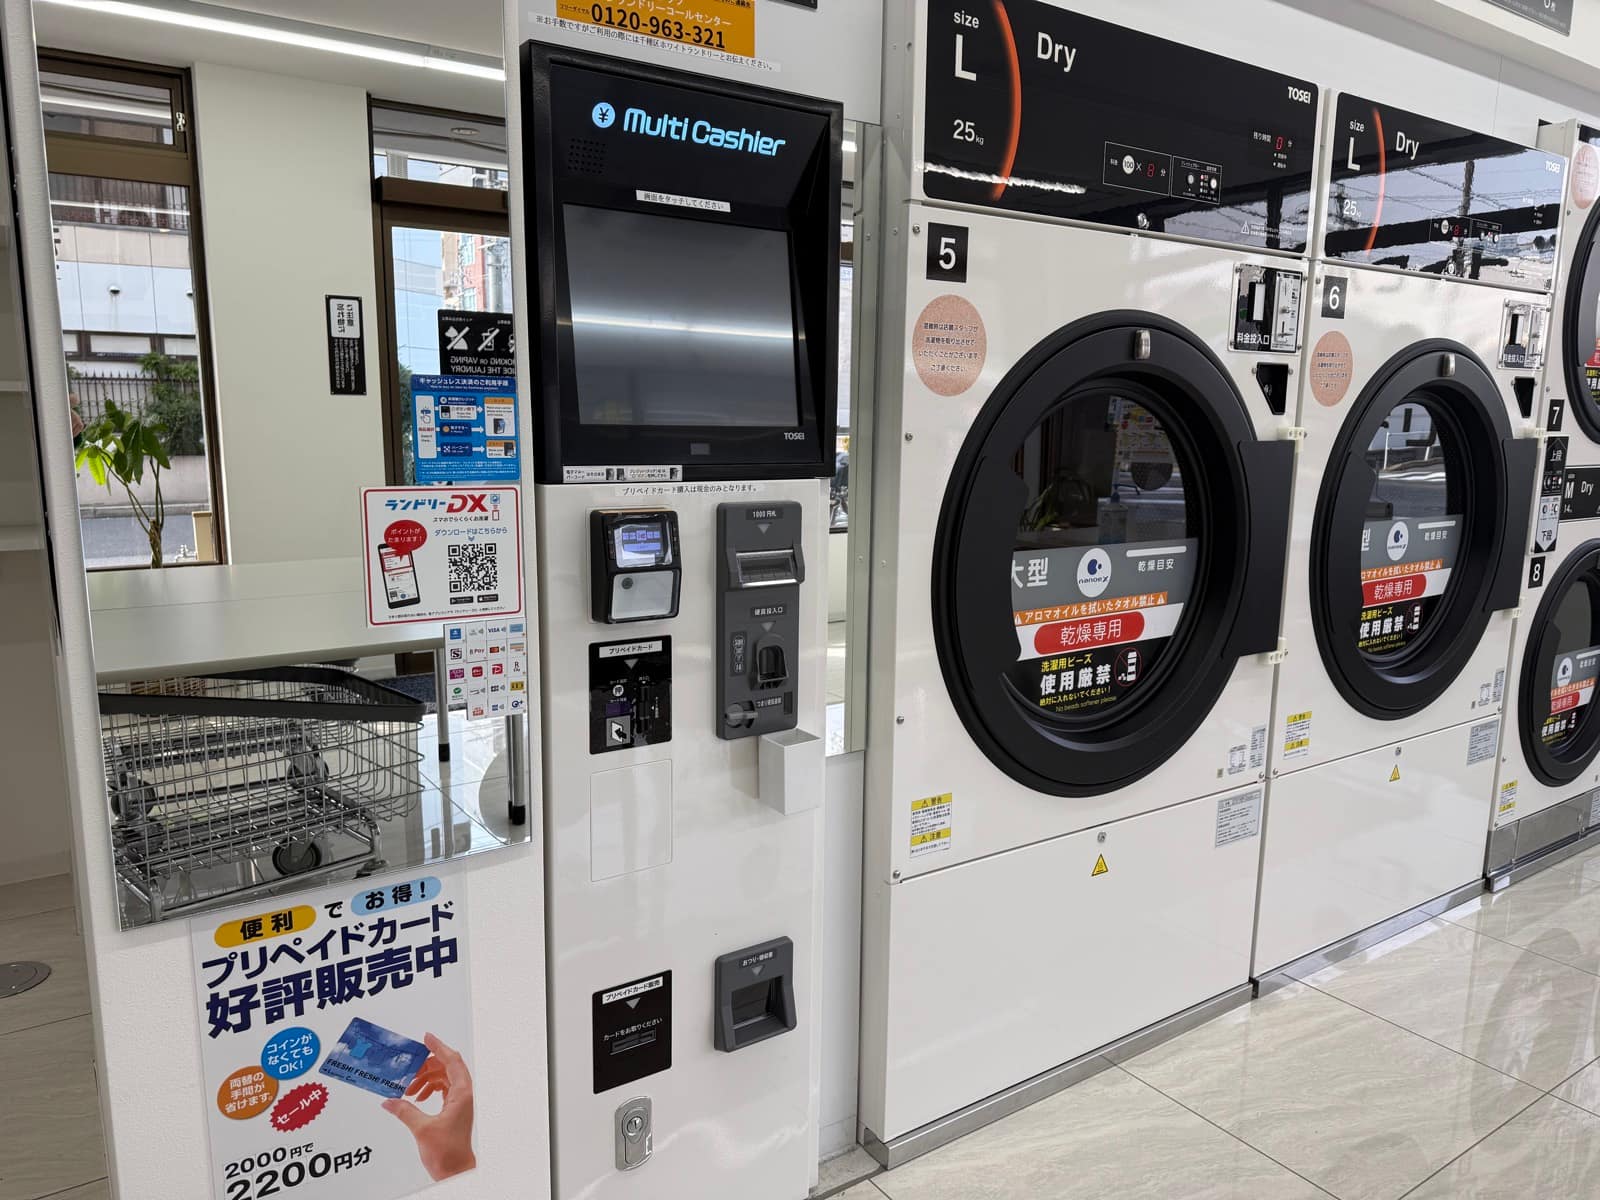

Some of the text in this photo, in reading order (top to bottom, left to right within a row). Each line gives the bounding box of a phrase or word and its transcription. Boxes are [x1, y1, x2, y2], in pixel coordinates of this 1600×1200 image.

[591, 3, 725, 49] 0120-963-321
[953, 10, 979, 29] size
[954, 34, 977, 81] L
[1036, 31, 1077, 73] Dry
[1287, 86, 1311, 104] TOSEI
[623, 107, 786, 156] Multi Cashier
[1349, 119, 1365, 133] size
[1347, 137, 1361, 171] L
[1395, 131, 1420, 161] Dry
[938, 236, 957, 271] 5
[1329, 286, 1340, 310] 6
[1237, 332, 1270, 345] 料金投入口
[1552, 406, 1560, 425] 7
[783, 432, 805, 441] TOSEI
[622, 484, 757, 495] プリペイドカード購入は現金のみとなります。
[1564, 481, 1575, 499] M
[1581, 480, 1594, 496] Dry
[391, 528, 420, 536] ポイントが
[434, 527, 508, 537] ダウンロードはこちらから
[1138, 559, 1175, 573] 乾燥目安
[1532, 563, 1541, 582] 8
[1374, 579, 1413, 600] 乾燥専用
[1025, 592, 1156, 623] アロマオイルを拭いたタオル禁止
[1060, 619, 1122, 647] 乾燥専用
[1360, 615, 1404, 639] 使用厳禁
[609, 645, 653, 654] プリペイドカード
[1040, 663, 1111, 696] 使用厳禁
[240, 910, 293, 941] 便利
[324, 901, 344, 919] で
[202, 900, 454, 989] プリペイドカード
[205, 936, 458, 1039] 好評販売中
[266, 1033, 313, 1054] コインが
[268, 1046, 313, 1065] なくても
[279, 1060, 303, 1074] OK!
[229, 1071, 265, 1090] 両替の
[231, 1082, 265, 1100] 手間が
[225, 1092, 273, 1113] 省けます。
[276, 1089, 322, 1124] セール中
